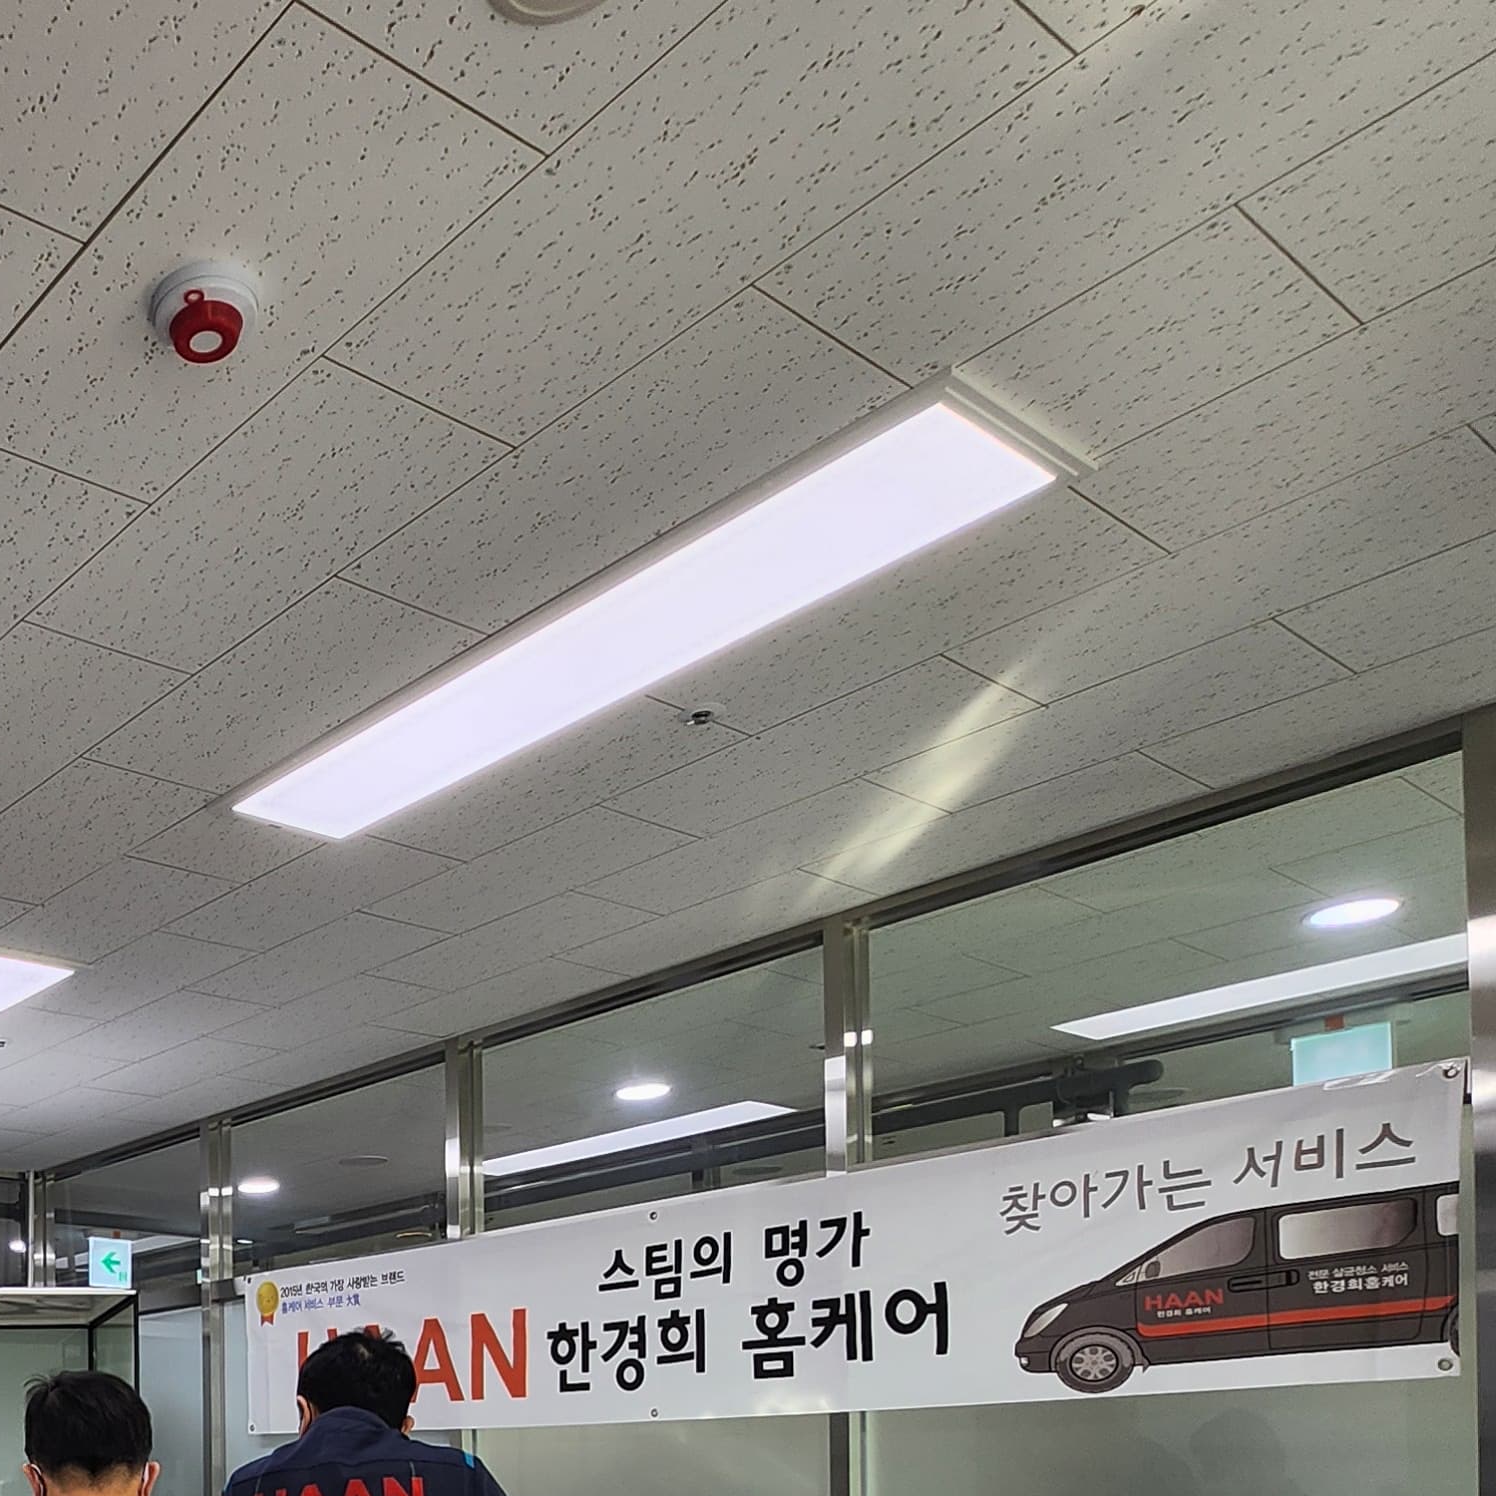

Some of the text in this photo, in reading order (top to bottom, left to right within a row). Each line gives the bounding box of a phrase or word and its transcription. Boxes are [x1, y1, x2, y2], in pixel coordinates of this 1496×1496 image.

[999, 1122, 1416, 1237] 찾아가는 서비스
[280, 1283, 303, 1299] 2015년
[305, 1280, 328, 1295] 한국의
[330, 1278, 344, 1292] 가장
[380, 1270, 405, 1285] 브랜드
[598, 1211, 871, 1300] 스팀의 명가
[1143, 1288, 1224, 1311] HAAN
[298, 1308, 527, 1403] AN
[546, 1281, 949, 1392] 한경희 홈케어
